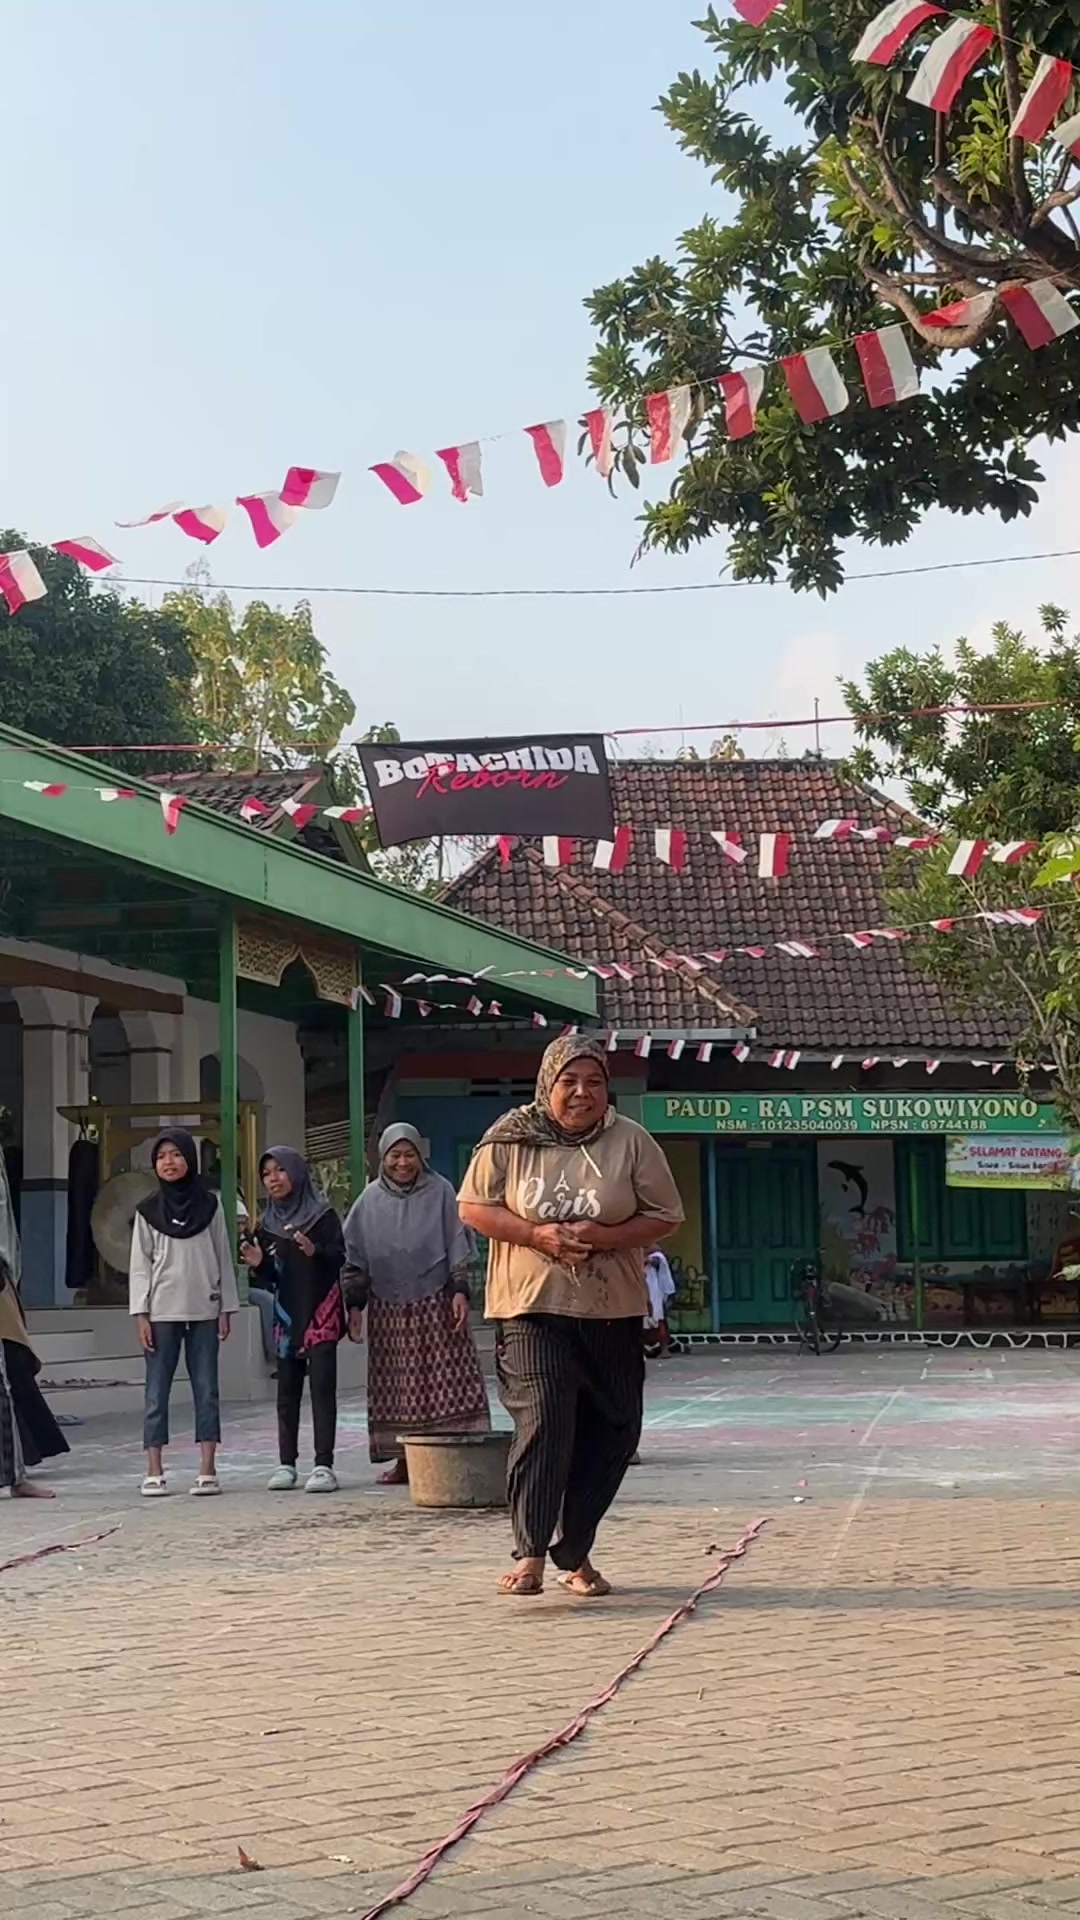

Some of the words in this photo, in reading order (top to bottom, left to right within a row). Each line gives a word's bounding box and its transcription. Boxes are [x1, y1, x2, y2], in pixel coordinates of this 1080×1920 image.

[415, 761, 568, 799] Reborn
[666, 1099, 731, 1117] PAUD
[759, 1099, 792, 1117] RA
[802, 1099, 853, 1117] PSM
[863, 1099, 1038, 1117] SUKOWIYONO
[716, 1119, 747, 1130] NSM
[761, 1119, 858, 1130] 101235040039
[870, 1119, 909, 1130] NPSN
[921, 1119, 987, 1130] 69744188
[969, 1146, 1016, 1157] SELAMAT
[1020, 1148, 1062, 1158] DATANG
[516, 1176, 601, 1220] Paris
